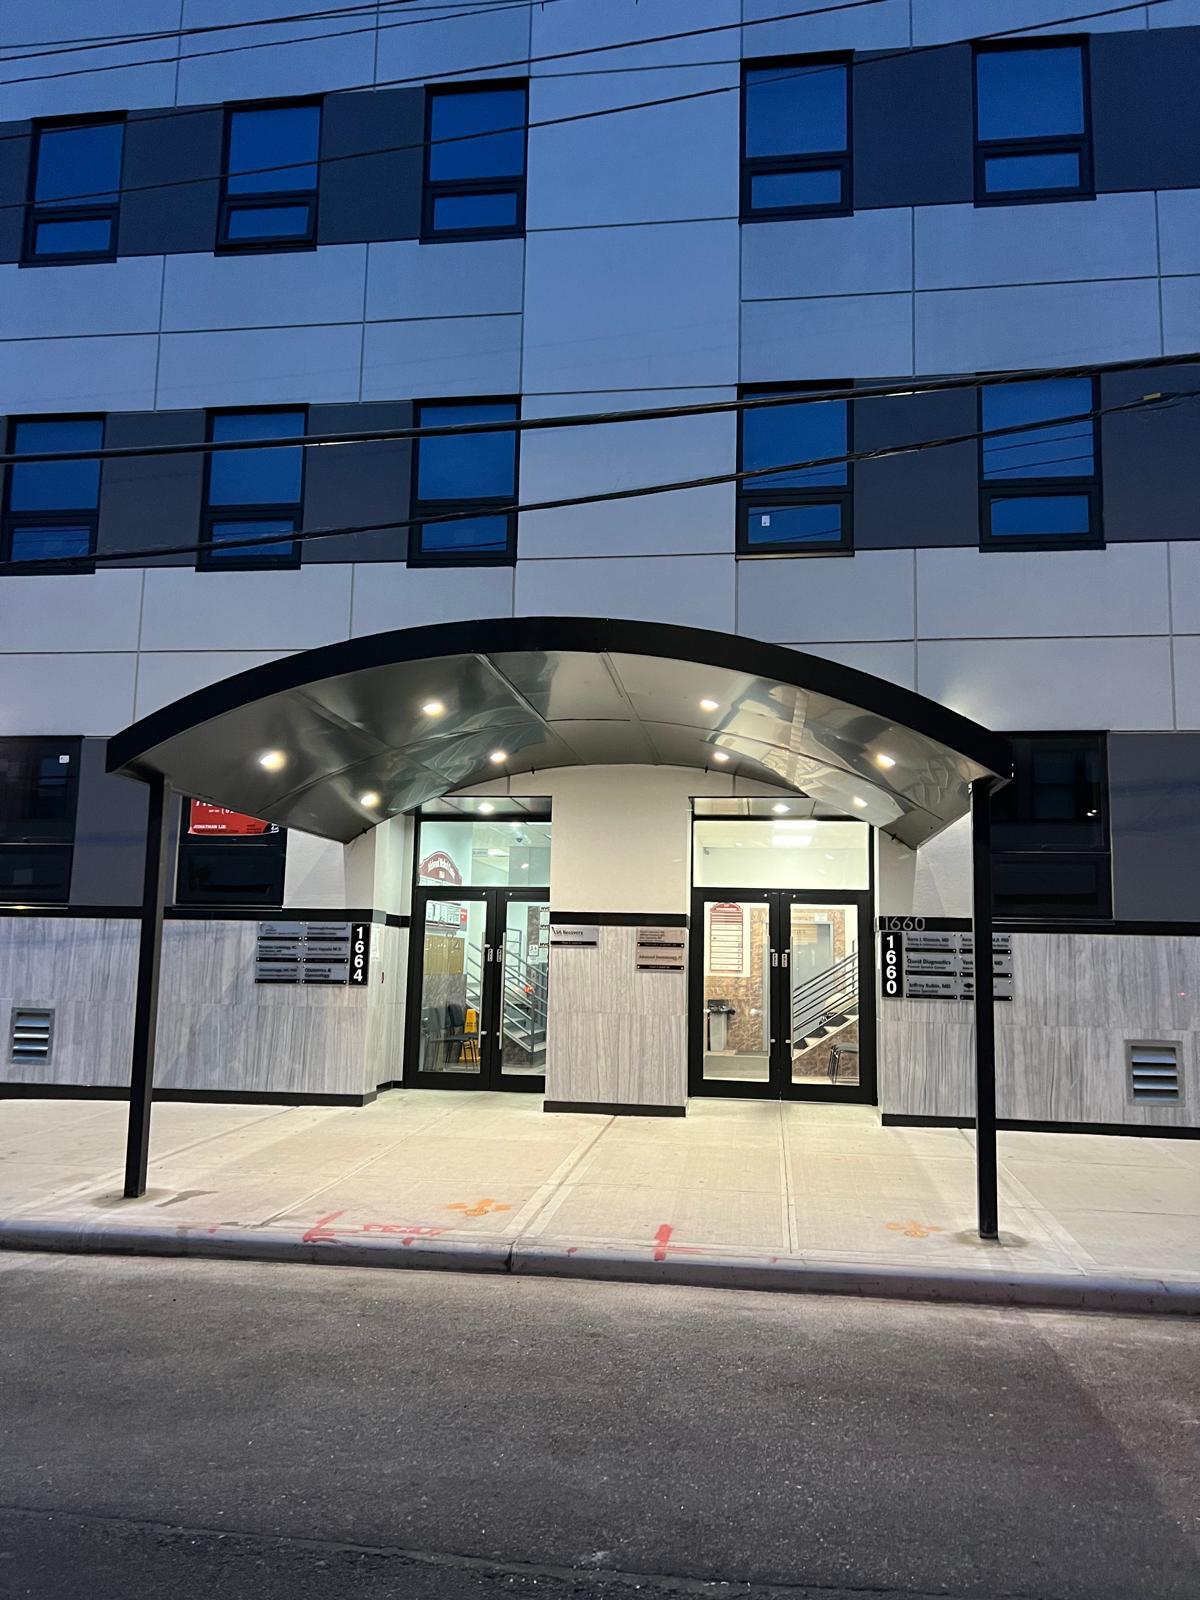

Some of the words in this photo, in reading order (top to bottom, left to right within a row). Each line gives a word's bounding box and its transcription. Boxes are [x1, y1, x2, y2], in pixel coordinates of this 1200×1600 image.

[883, 917, 926, 931] 1660
[353, 926, 366, 983] 1664
[886, 935, 898, 995] 1660
